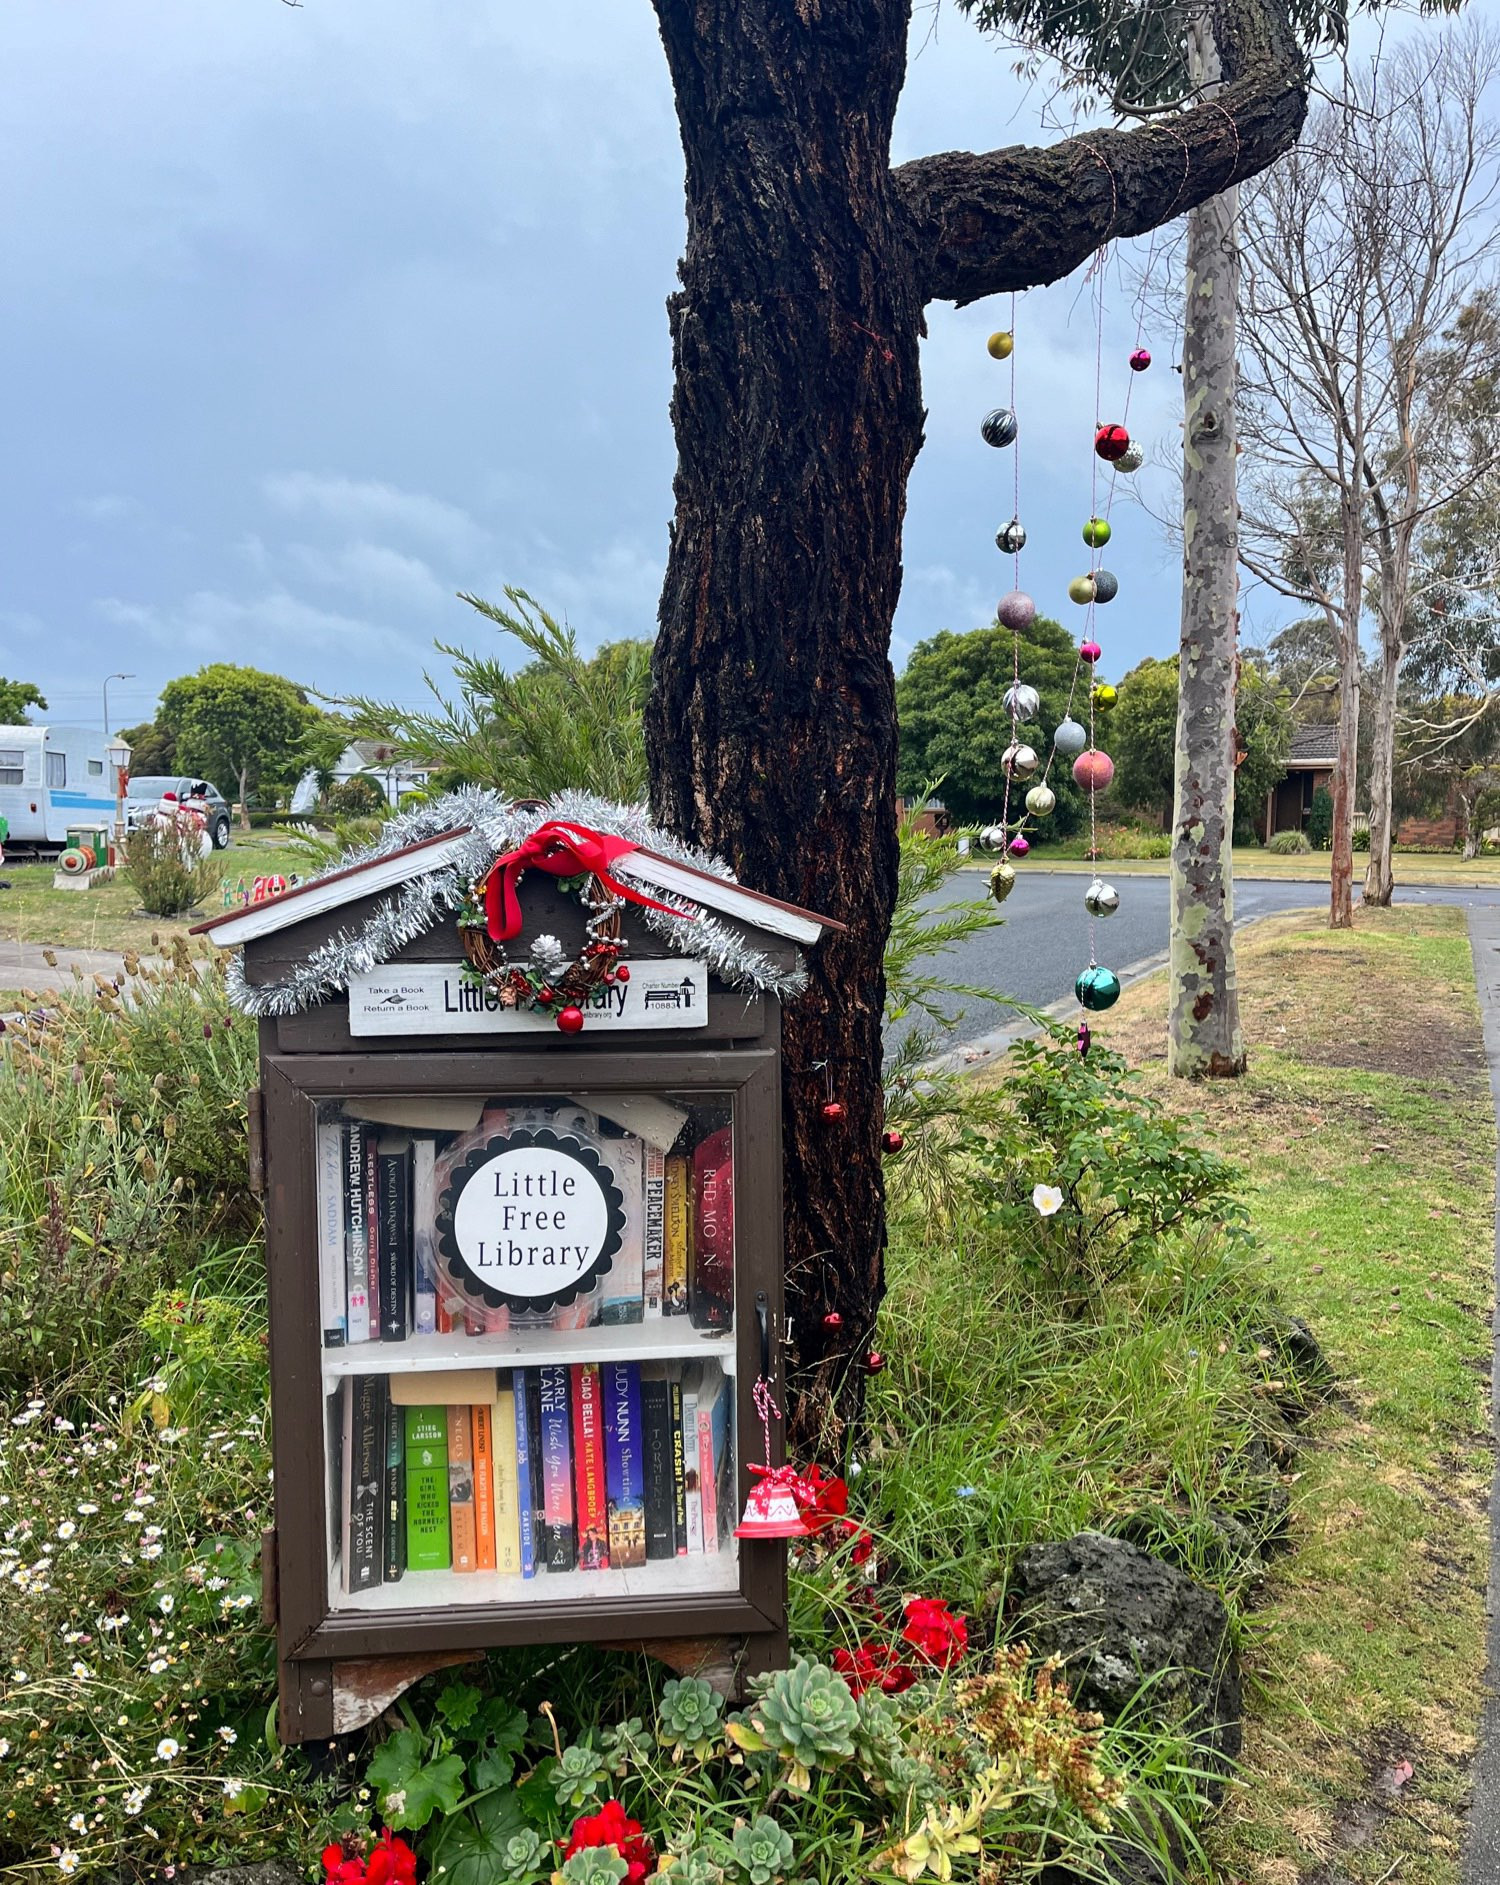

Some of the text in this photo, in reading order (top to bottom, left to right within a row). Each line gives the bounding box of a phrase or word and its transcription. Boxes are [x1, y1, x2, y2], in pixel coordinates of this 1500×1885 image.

[401, 986, 425, 994] Book
[406, 1004, 430, 1012] Book
[444, 979, 499, 1012] Little
[651, 1002, 676, 1010] 10883
[349, 1125, 361, 1186] ANDREW
[367, 1153, 375, 1215] RESTLESS
[493, 1170, 576, 1197] Little
[327, 1195, 337, 1246] SADDAM
[350, 1188, 365, 1276] HUTCHINSON
[502, 1205, 566, 1231] Free
[646, 1180, 663, 1260] PEACEMAKER
[670, 1192, 681, 1238] SHELDON
[703, 1169, 717, 1266] RED MON
[477, 1239, 590, 1271] Library
[390, 1278, 397, 1286] OF
[540, 1367, 555, 1413] LANE
[554, 1366, 566, 1411] KARLY
[581, 1376, 594, 1438] CIAO BELLA!
[615, 1365, 630, 1442] JUDY NUNN
[360, 1375, 375, 1478] Maggie Alderson
[412, 1432, 441, 1440] LARSSON
[417, 1424, 436, 1432] STIEG
[455, 1417, 463, 1458] NEGUS
[518, 1448, 528, 1464] Job
[585, 1440, 594, 1464] KATE
[651, 1429, 662, 1509] TORMENT
[673, 1430, 683, 1482] CRASH!
[545, 1418, 567, 1541] Wish You Were Here
[417, 1501, 440, 1509] KICKED
[356, 1513, 364, 1553] OF YOU
[365, 1502, 374, 1559] THE SCENT
[522, 1510, 530, 1545] GARSIDE
